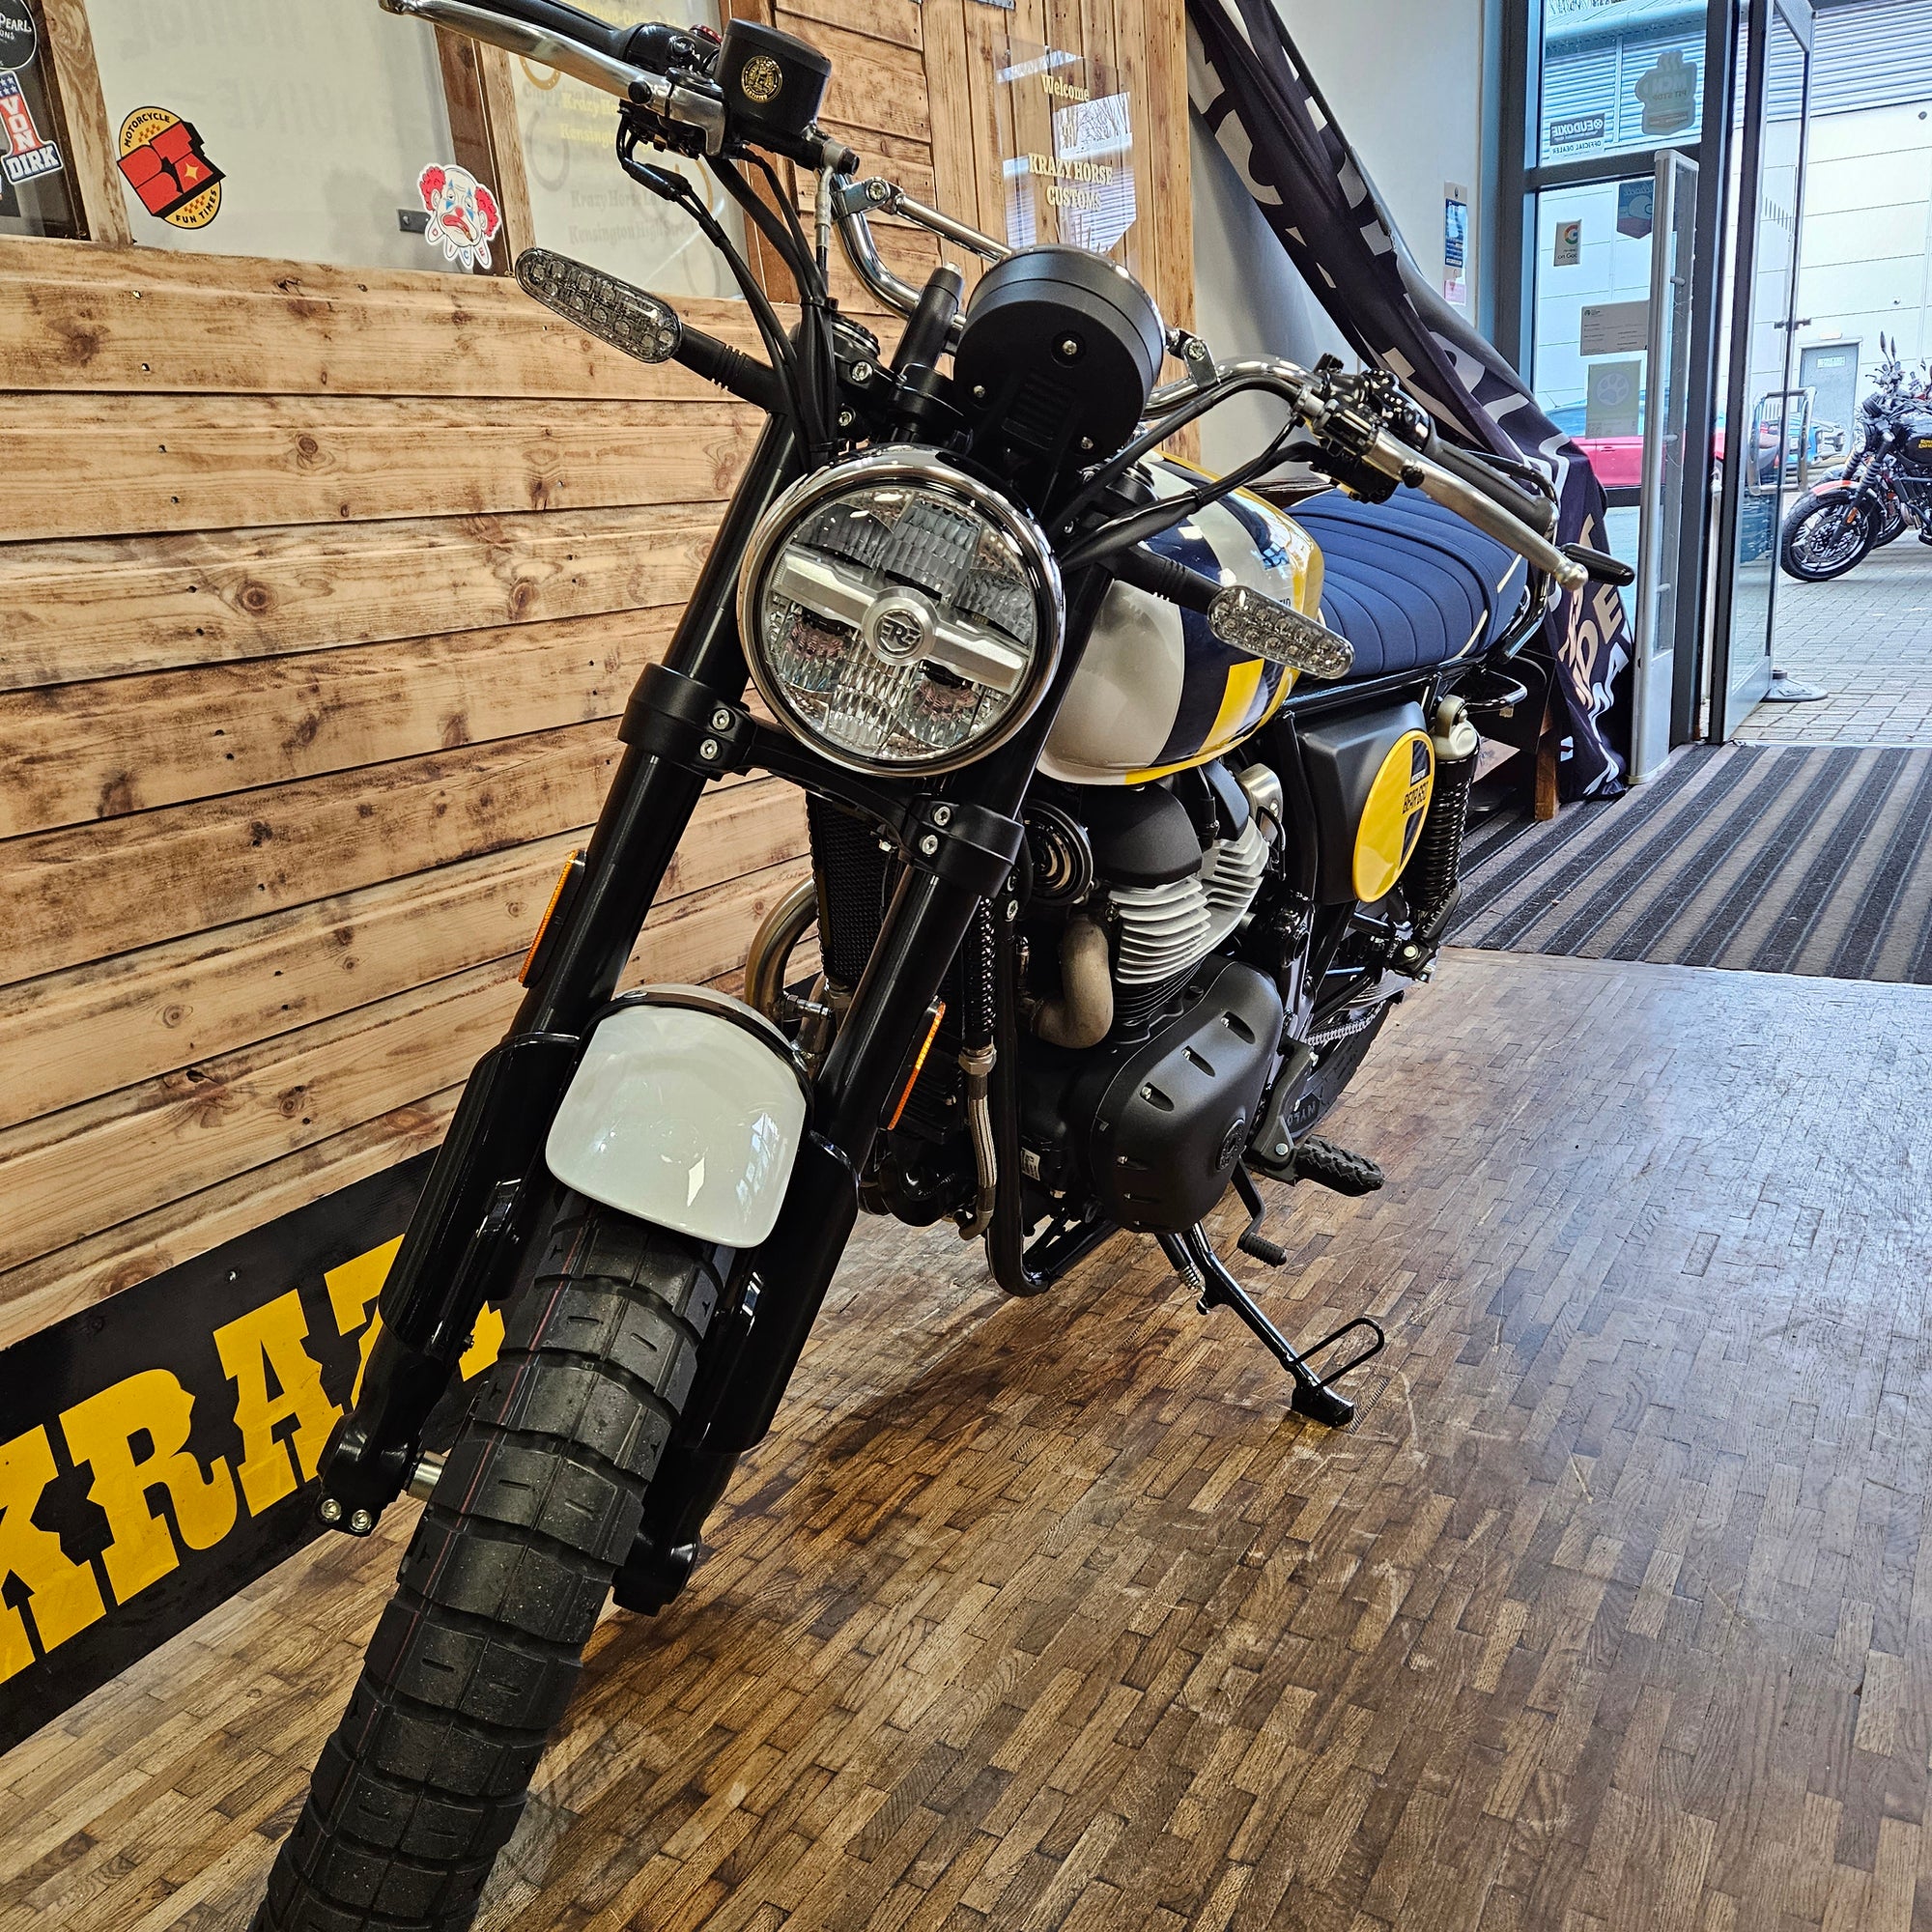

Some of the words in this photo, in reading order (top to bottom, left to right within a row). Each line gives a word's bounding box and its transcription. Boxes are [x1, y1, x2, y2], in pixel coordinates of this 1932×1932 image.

[1040, 73, 1091, 102] Welcome
[1, 96, 37, 153] VON
[124, 112, 171, 148] MOTORCYCLE
[6, 145, 59, 180] DIRK
[1028, 153, 1073, 180] KRAZY
[1074, 162, 1113, 185] HORSE
[175, 213, 198, 224] FUN
[198, 188, 217, 219] TIMES
[1046, 185, 1102, 212] CUSTOMS
